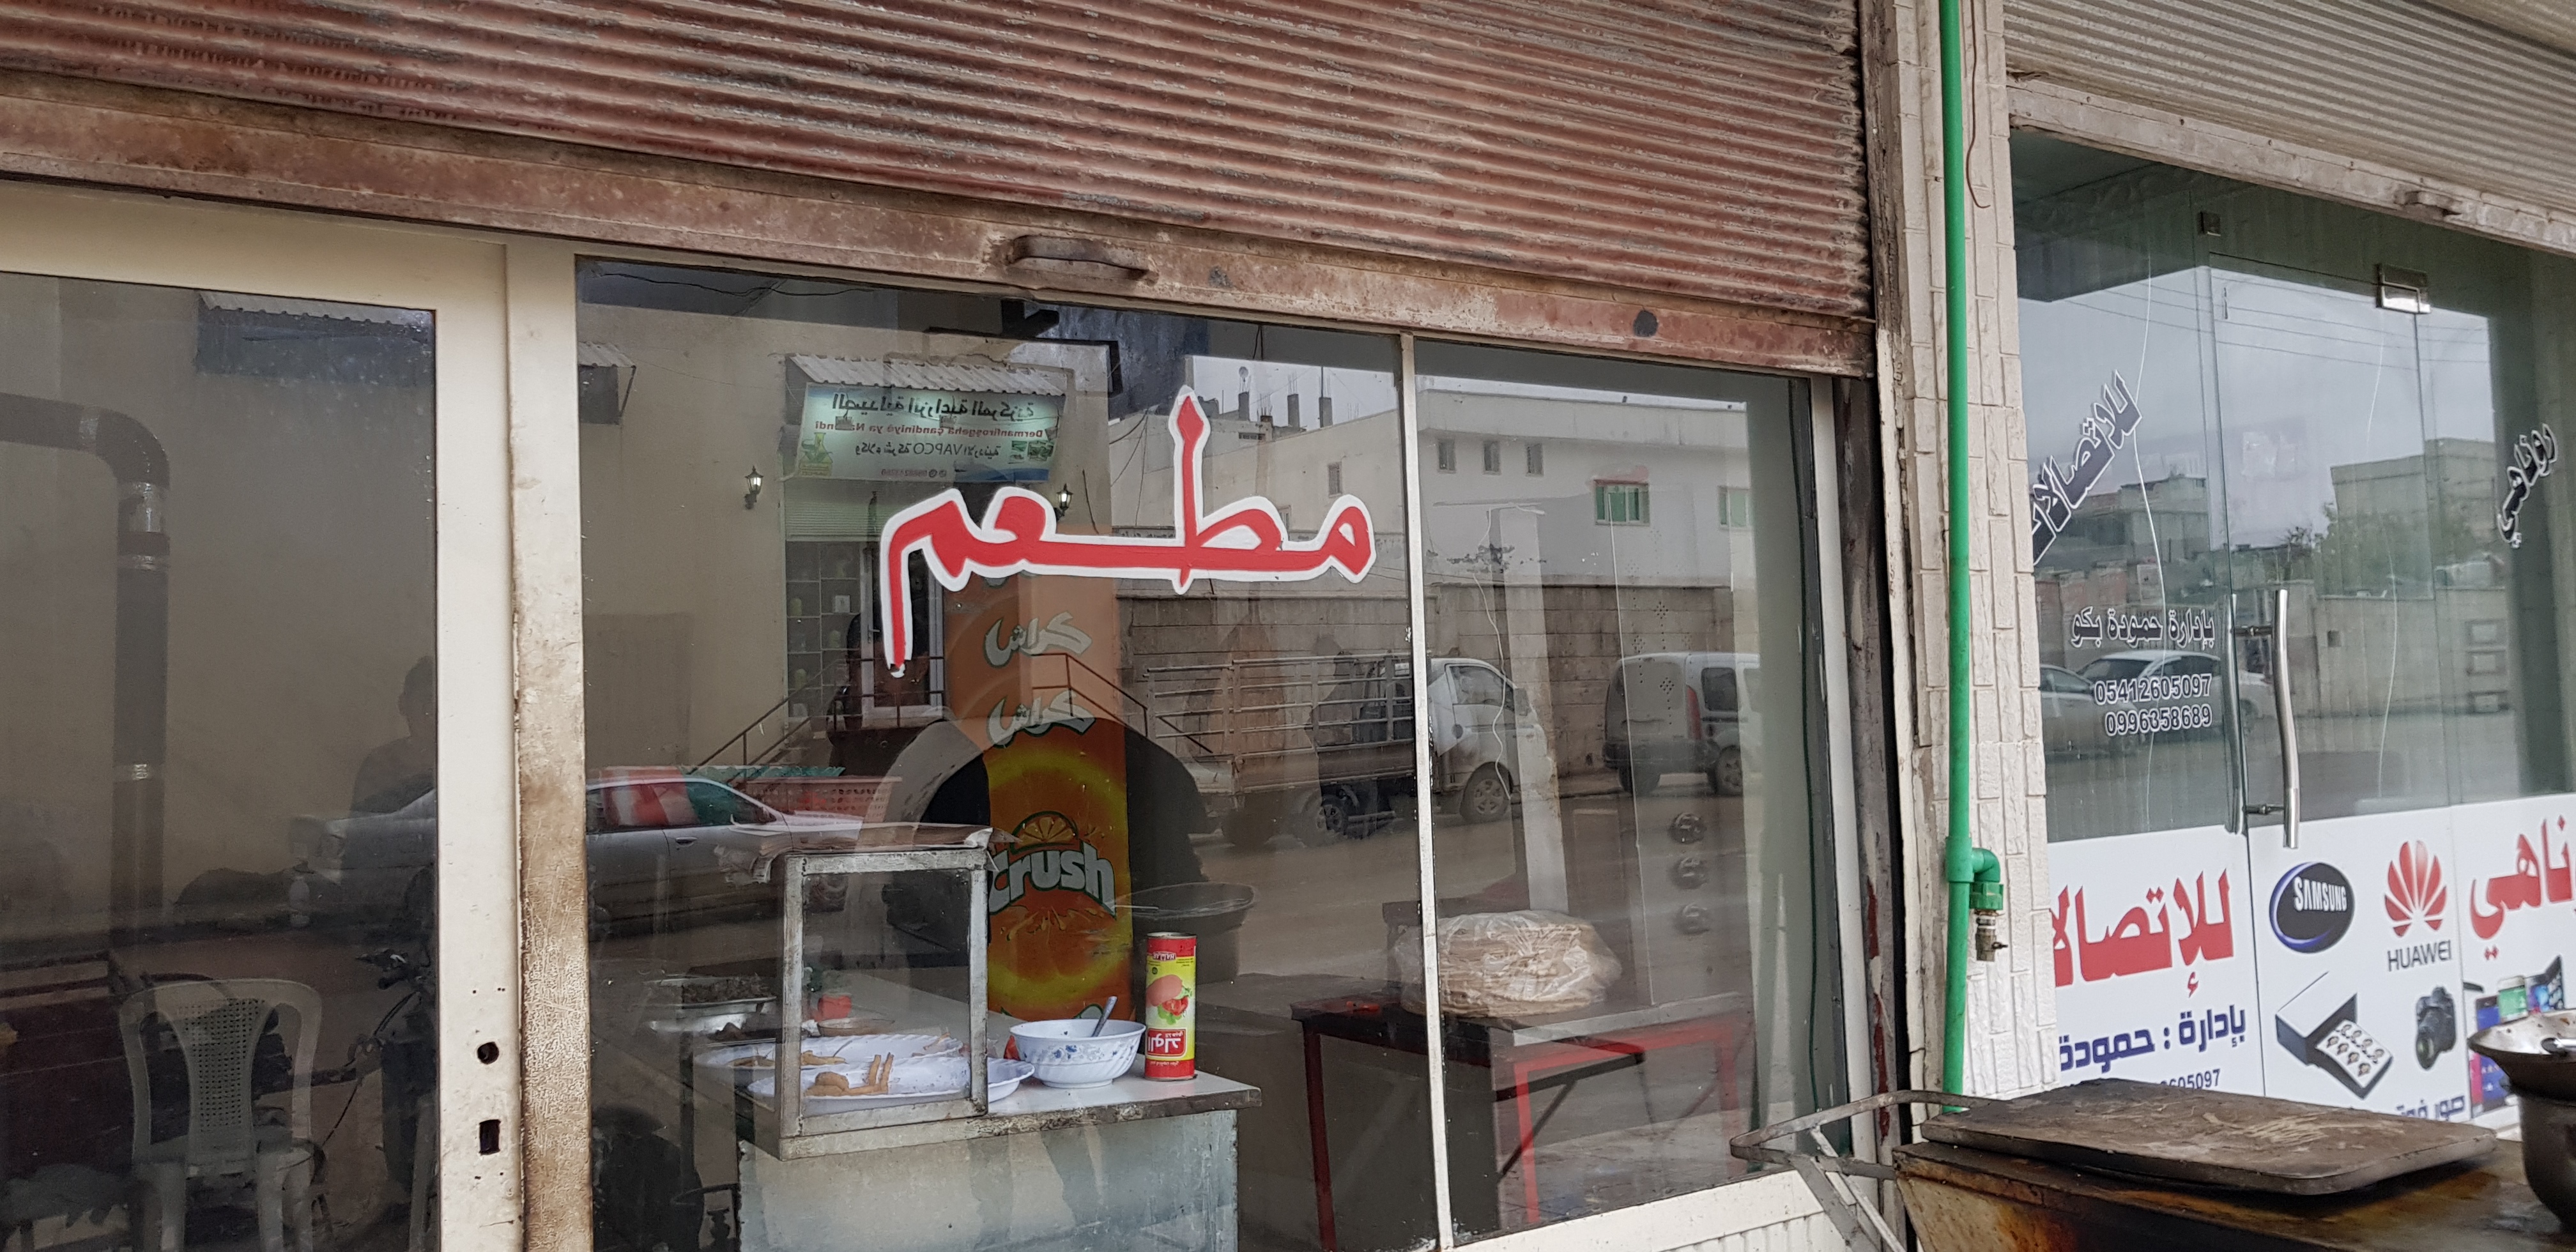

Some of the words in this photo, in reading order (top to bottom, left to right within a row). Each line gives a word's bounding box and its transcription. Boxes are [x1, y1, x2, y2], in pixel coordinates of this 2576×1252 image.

[880, 385, 1376, 678] مطعم
[983, 611, 1092, 668] كراش
[2108, 608, 2163, 648] حمودة
[2094, 673, 2212, 705] 05412605097
[2105, 703, 2212, 737] 0996358689
[990, 841, 1117, 919] Crush
[2293, 876, 2348, 912] SAMSUNG
[2470, 815, 2576, 960] ناهي
[2387, 940, 2452, 972] HUAWEI
[1148, 1033, 1181, 1053] الولد
[2179, 1004, 2246, 1053] بإدارة
[2058, 1028, 2155, 1073] حمودة
